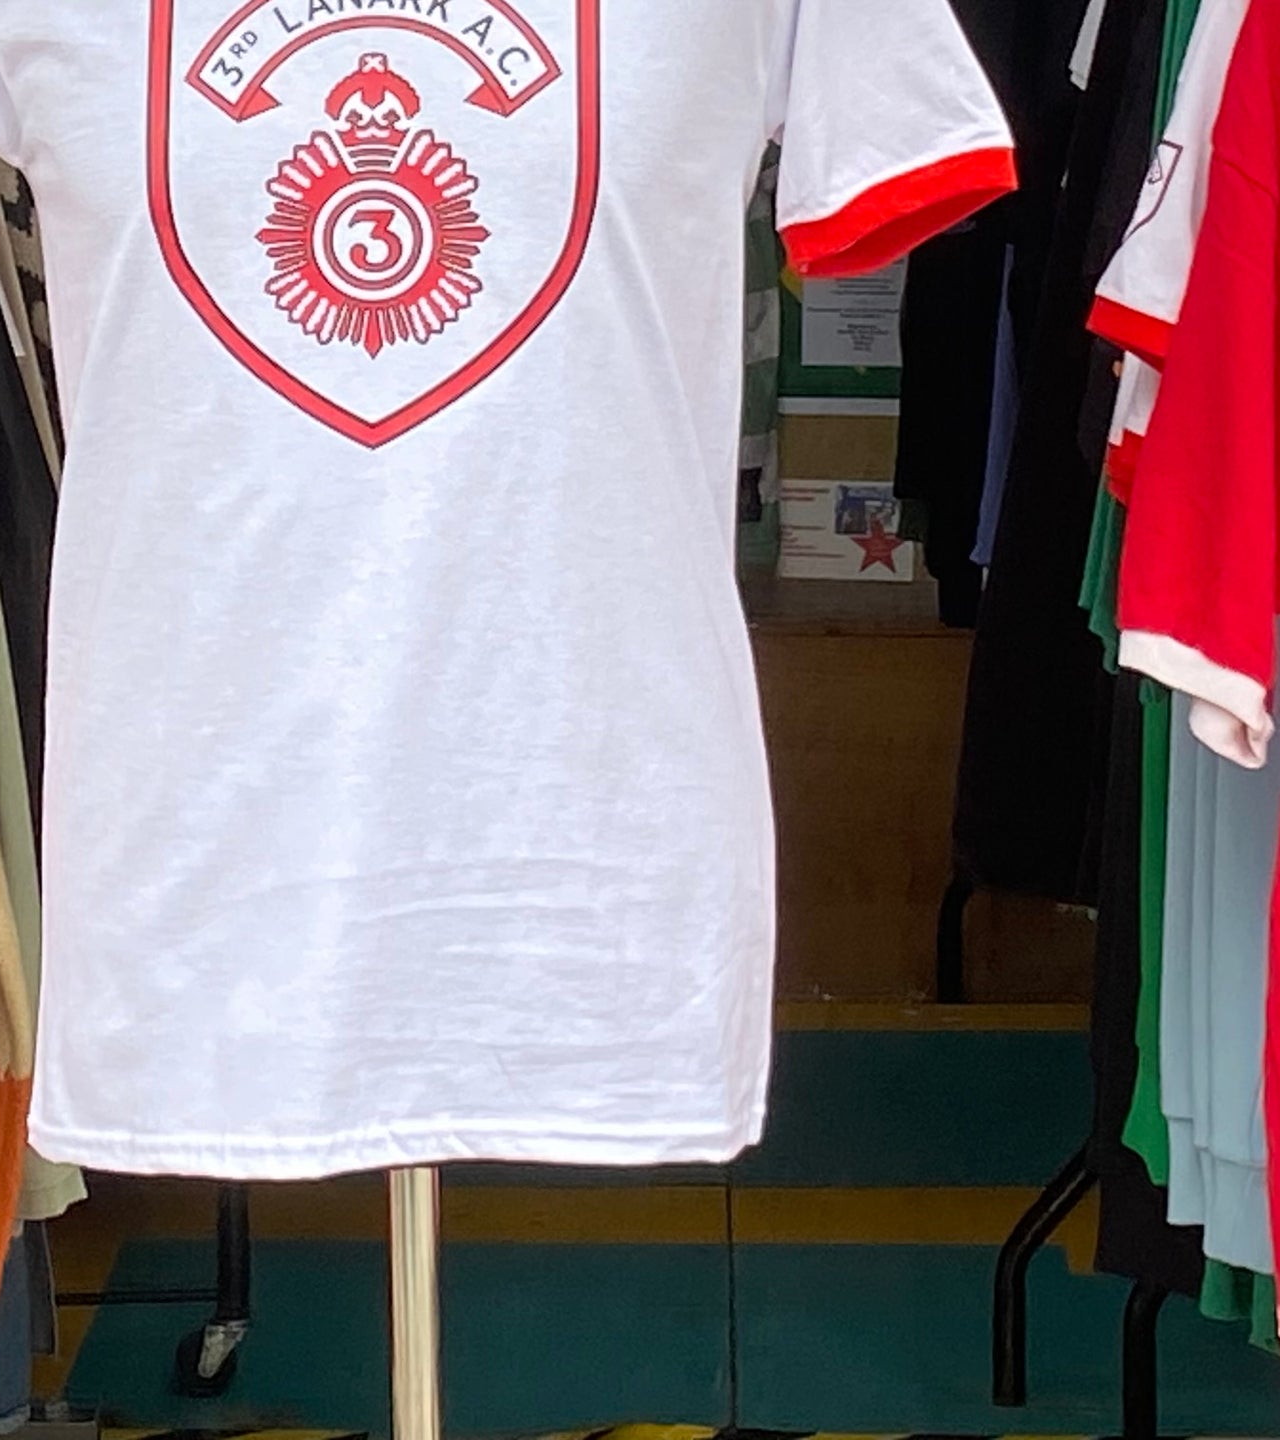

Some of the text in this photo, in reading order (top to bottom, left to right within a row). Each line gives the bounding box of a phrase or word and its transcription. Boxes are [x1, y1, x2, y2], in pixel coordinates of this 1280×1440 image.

[211, 30, 258, 87] 3RD
[462, 15, 530, 86] A.C.
[347, 209, 403, 272] 3
